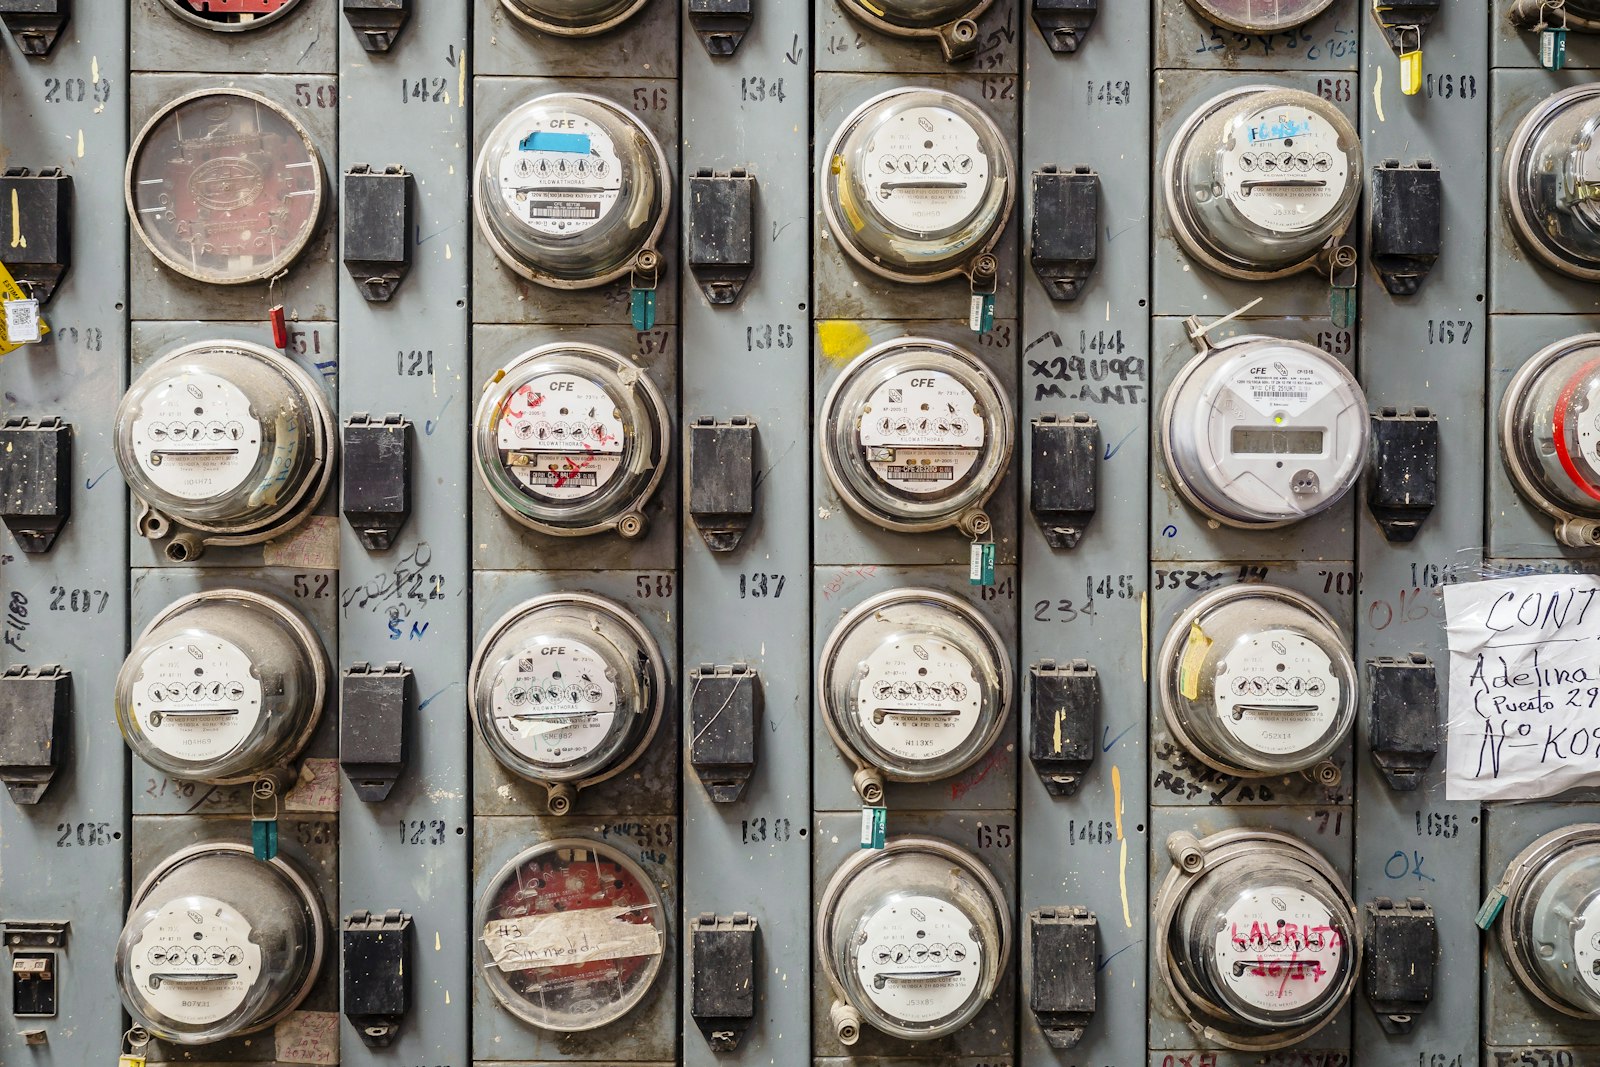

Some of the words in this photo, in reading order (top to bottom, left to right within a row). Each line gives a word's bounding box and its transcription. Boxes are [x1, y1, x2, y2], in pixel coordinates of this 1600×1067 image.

[44, 78, 111, 103] 209
[294, 82, 337, 108] 50
[402, 77, 448, 104] 142
[741, 77, 787, 103] 134
[1317, 78, 1351, 102] 68
[1426, 73, 1476, 99] 168
[633, 87, 668, 111] 56
[549, 119, 576, 129] CFE
[291, 330, 321, 354] 51
[637, 331, 669, 355] 57
[747, 324, 794, 351] 135
[1080, 330, 1126, 354] 144
[1317, 330, 1351, 354] 69
[1428, 320, 1472, 344] 167
[397, 350, 433, 376] 121
[549, 381, 575, 392] CFE
[910, 378, 936, 388] CFE
[294, 574, 330, 599] 52
[636, 575, 673, 598] 58
[740, 573, 787, 599] 137
[1086, 574, 1134, 599] 145
[50, 586, 109, 614] 207
[541, 647, 566, 656] CFE
[400, 820, 447, 845] 123
[978, 824, 1013, 848] 65
[1315, 811, 1344, 836] 71
[1385, 850, 1435, 881] OK
